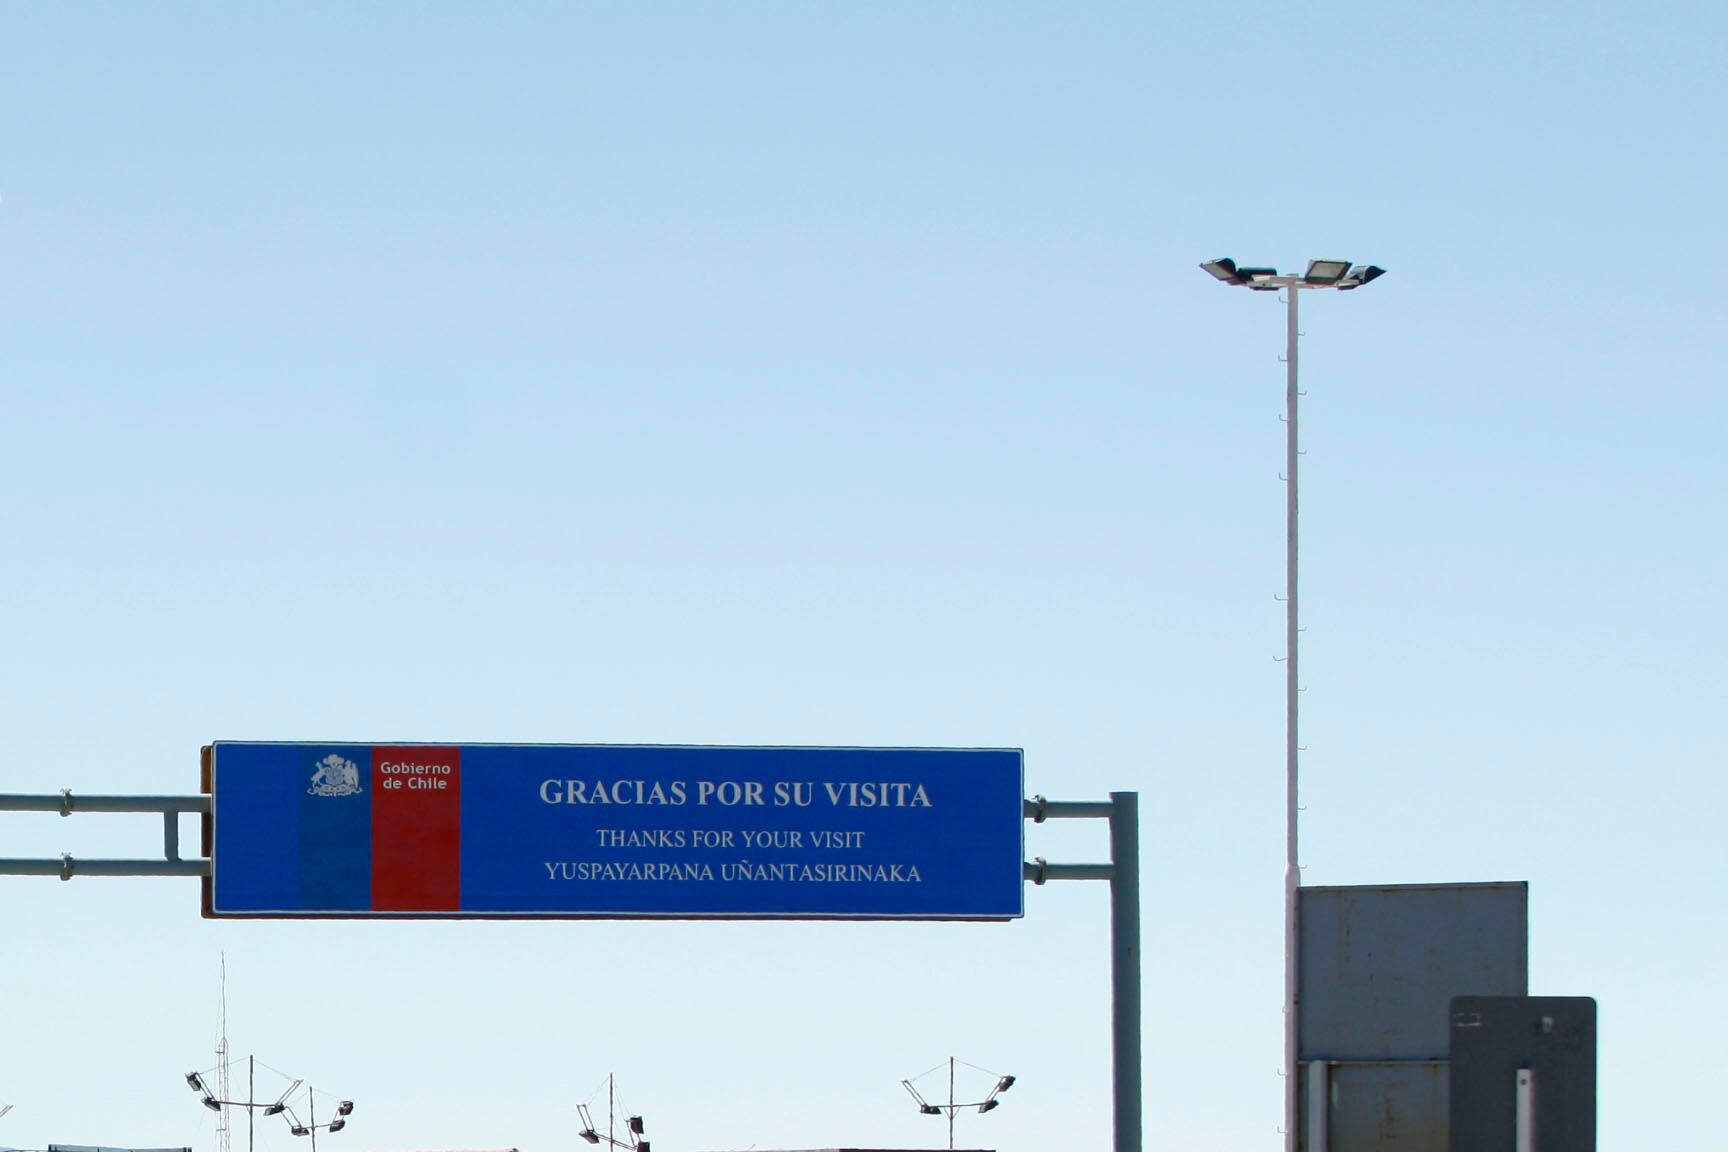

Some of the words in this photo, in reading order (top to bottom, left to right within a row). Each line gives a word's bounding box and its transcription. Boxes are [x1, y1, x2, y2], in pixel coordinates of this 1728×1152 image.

[380, 761, 451, 775] Gobierno
[383, 777, 402, 790] de
[407, 777, 448, 790] Chile
[539, 779, 688, 806] GRACIAS
[696, 781, 766, 806] POR
[774, 781, 815, 807] SU
[824, 782, 934, 808] VISITA
[595, 829, 687, 849] THANKS
[691, 830, 736, 849] FOR
[741, 830, 804, 849] YOUR
[810, 831, 866, 849] VISIT
[544, 861, 715, 881] YUSPAYARPANA
[720, 859, 923, 883] UÑANTASIRINAKA
